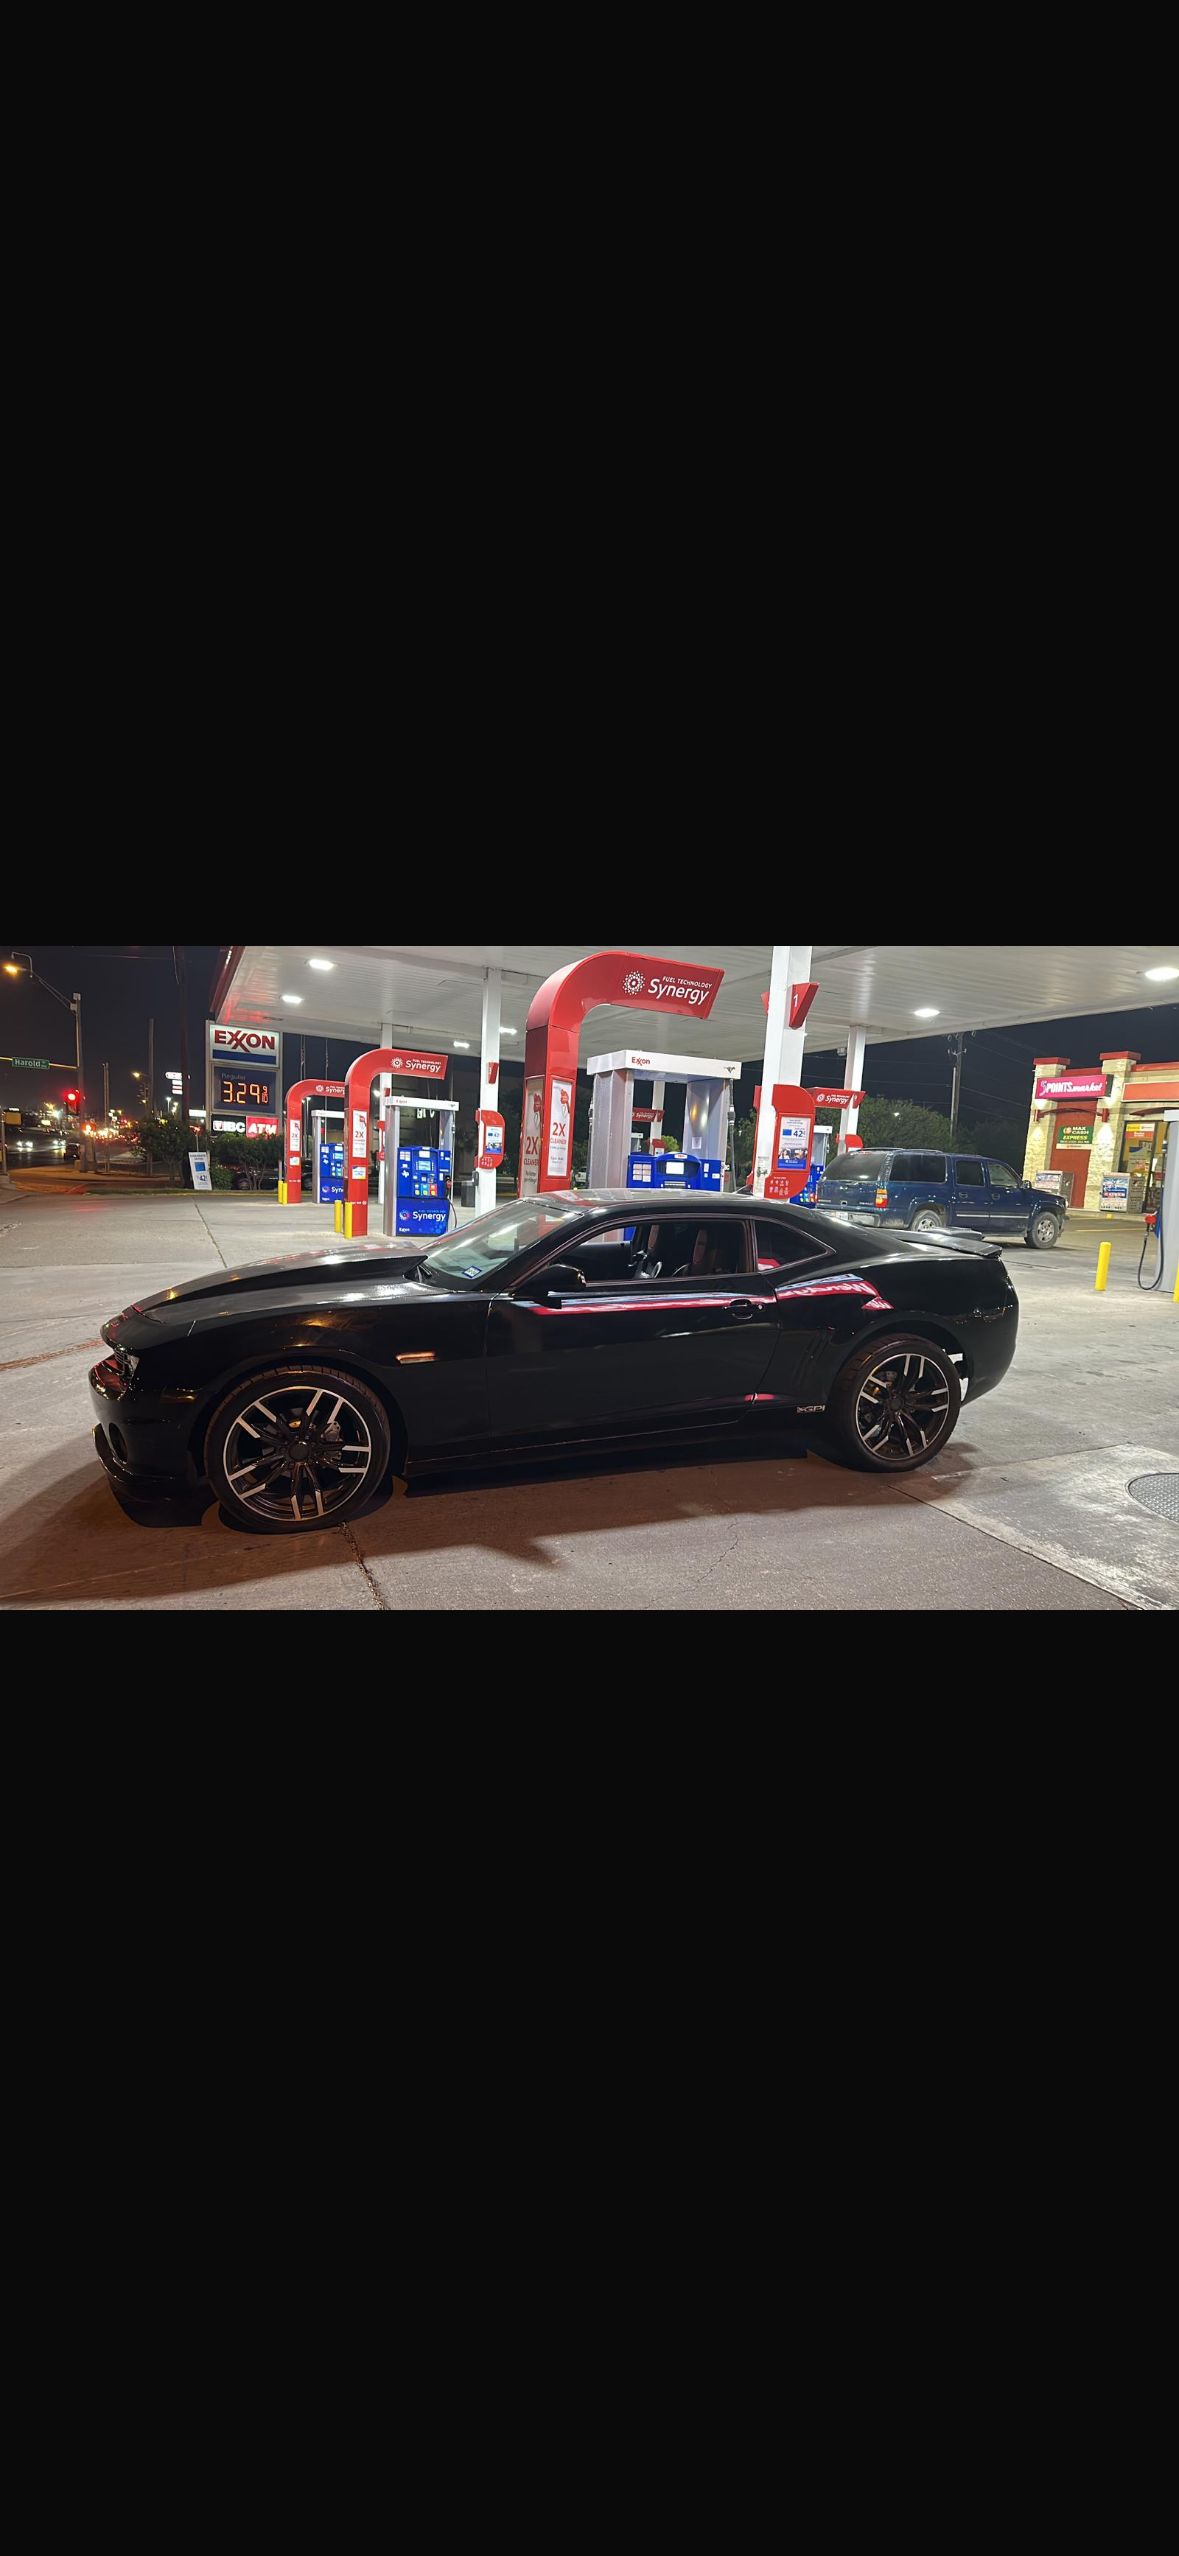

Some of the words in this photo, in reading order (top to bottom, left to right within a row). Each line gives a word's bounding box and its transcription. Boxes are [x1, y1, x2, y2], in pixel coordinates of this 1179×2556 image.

[662, 976, 677, 984] FUEL
[678, 977, 713, 989] TECHNOLOGY
[648, 978, 710, 1006] Synergy
[793, 993, 799, 1008] 1
[214, 1030, 276, 1053] EXXON
[405, 1060, 441, 1073] Synergy
[631, 1056, 651, 1067] Exxon
[248, 1122, 277, 1135] ATM
[552, 1122, 567, 1137] 2X
[525, 1136, 540, 1155] 2X
[412, 1211, 447, 1222] Synergy
